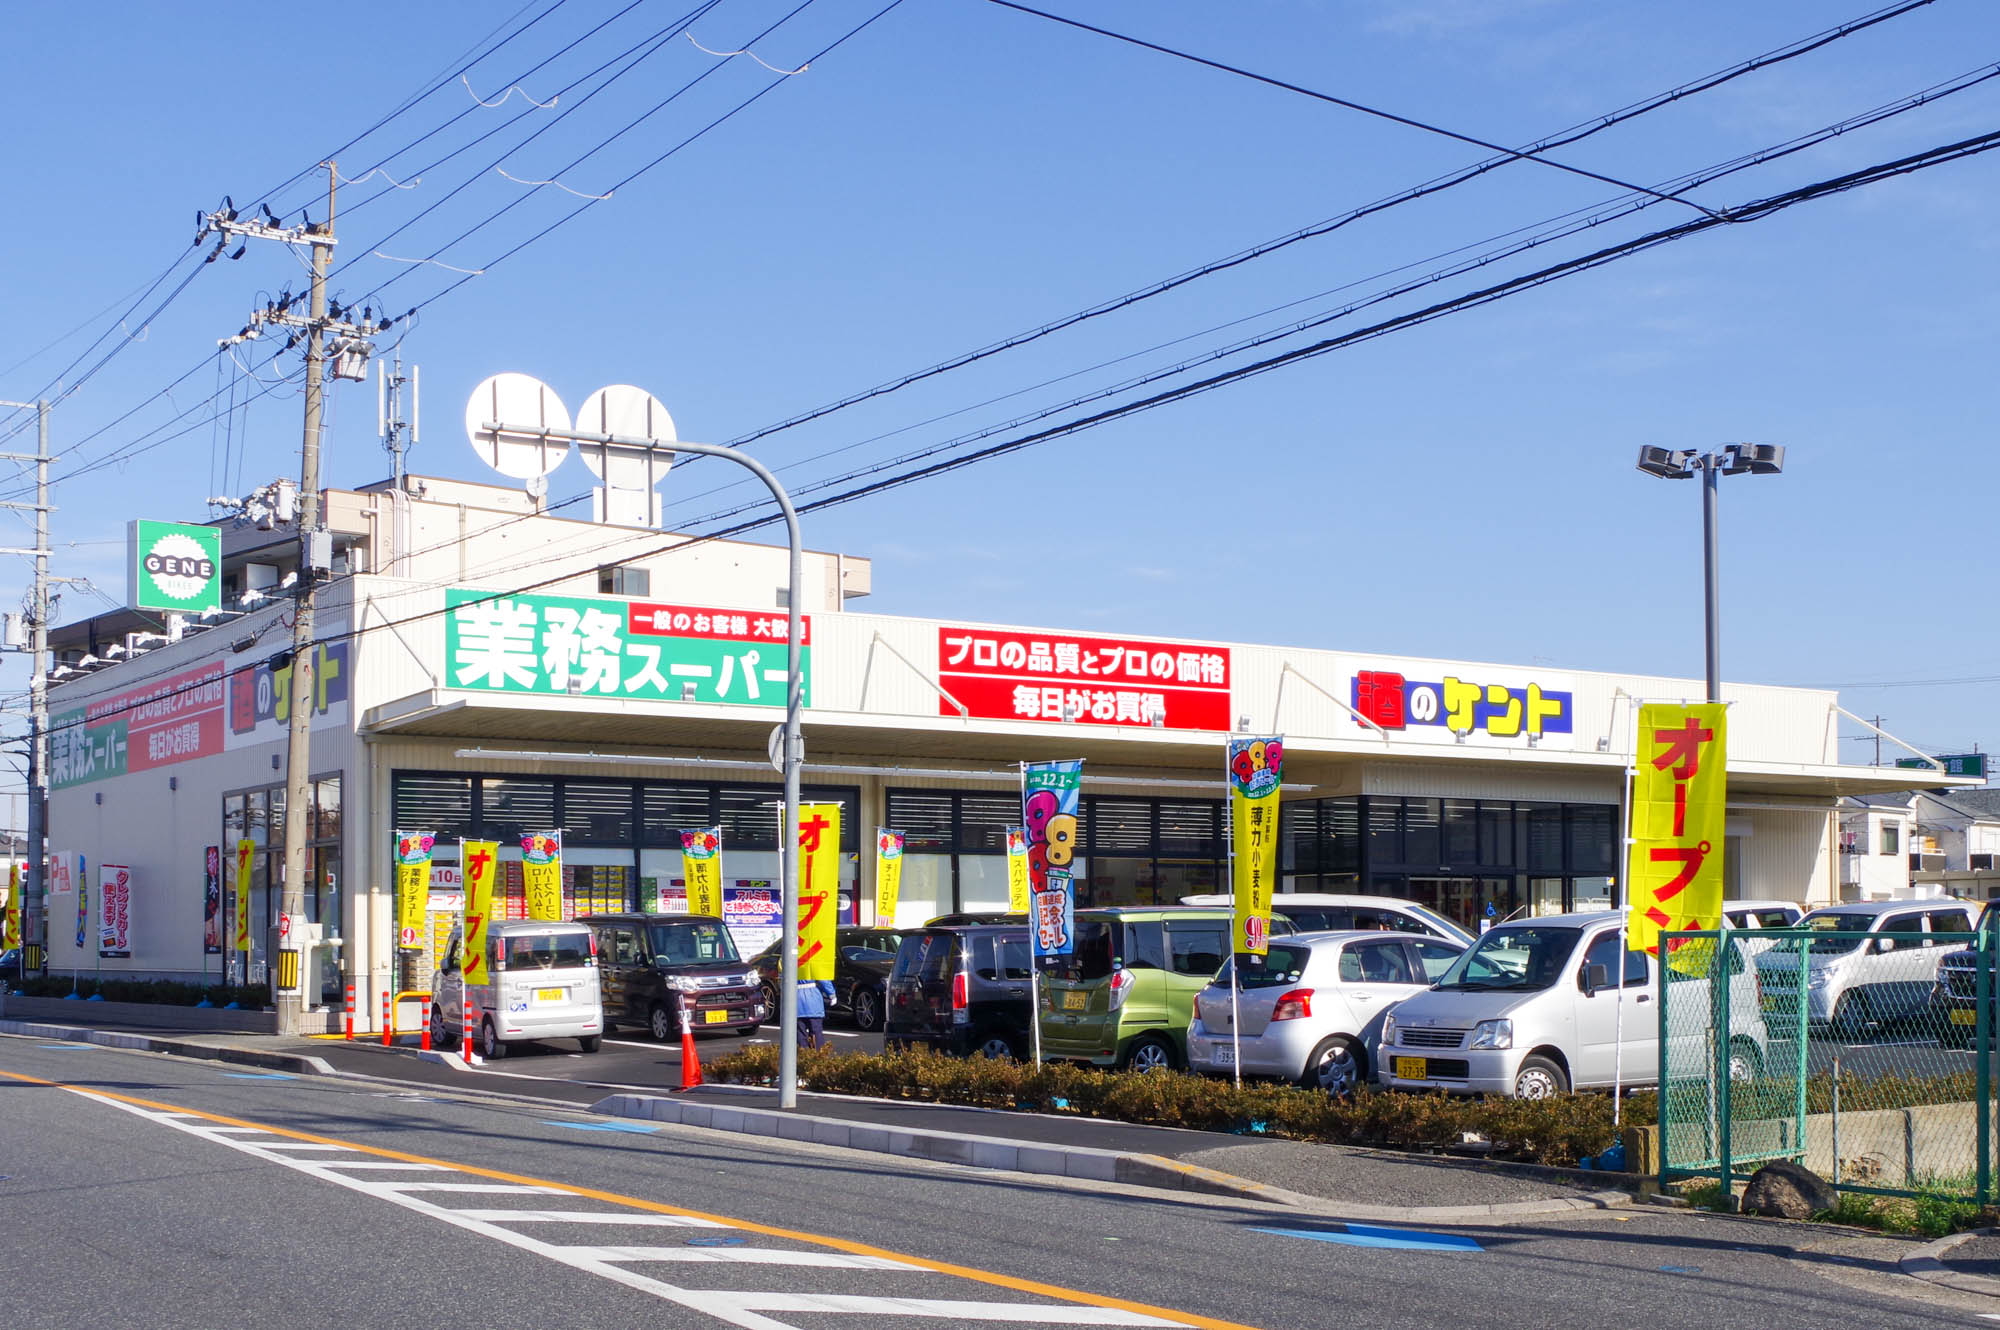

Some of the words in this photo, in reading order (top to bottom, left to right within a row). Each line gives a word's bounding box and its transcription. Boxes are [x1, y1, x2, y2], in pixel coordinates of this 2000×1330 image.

[147, 557, 211, 576] GENE
[634, 611, 748, 635] 一般のお客様
[455, 600, 804, 699] 業務スーパー
[946, 636, 1225, 684] プロの品質とプロの価格
[1012, 685, 1165, 723] 毎日がお買得
[149, 721, 200, 761] 毎日がお買得
[1645, 718, 1714, 957] オープン
[407, 868, 421, 917] 業務シチュー
[464, 850, 491, 976] オープン
[736, 890, 770, 902] アルミ缶
